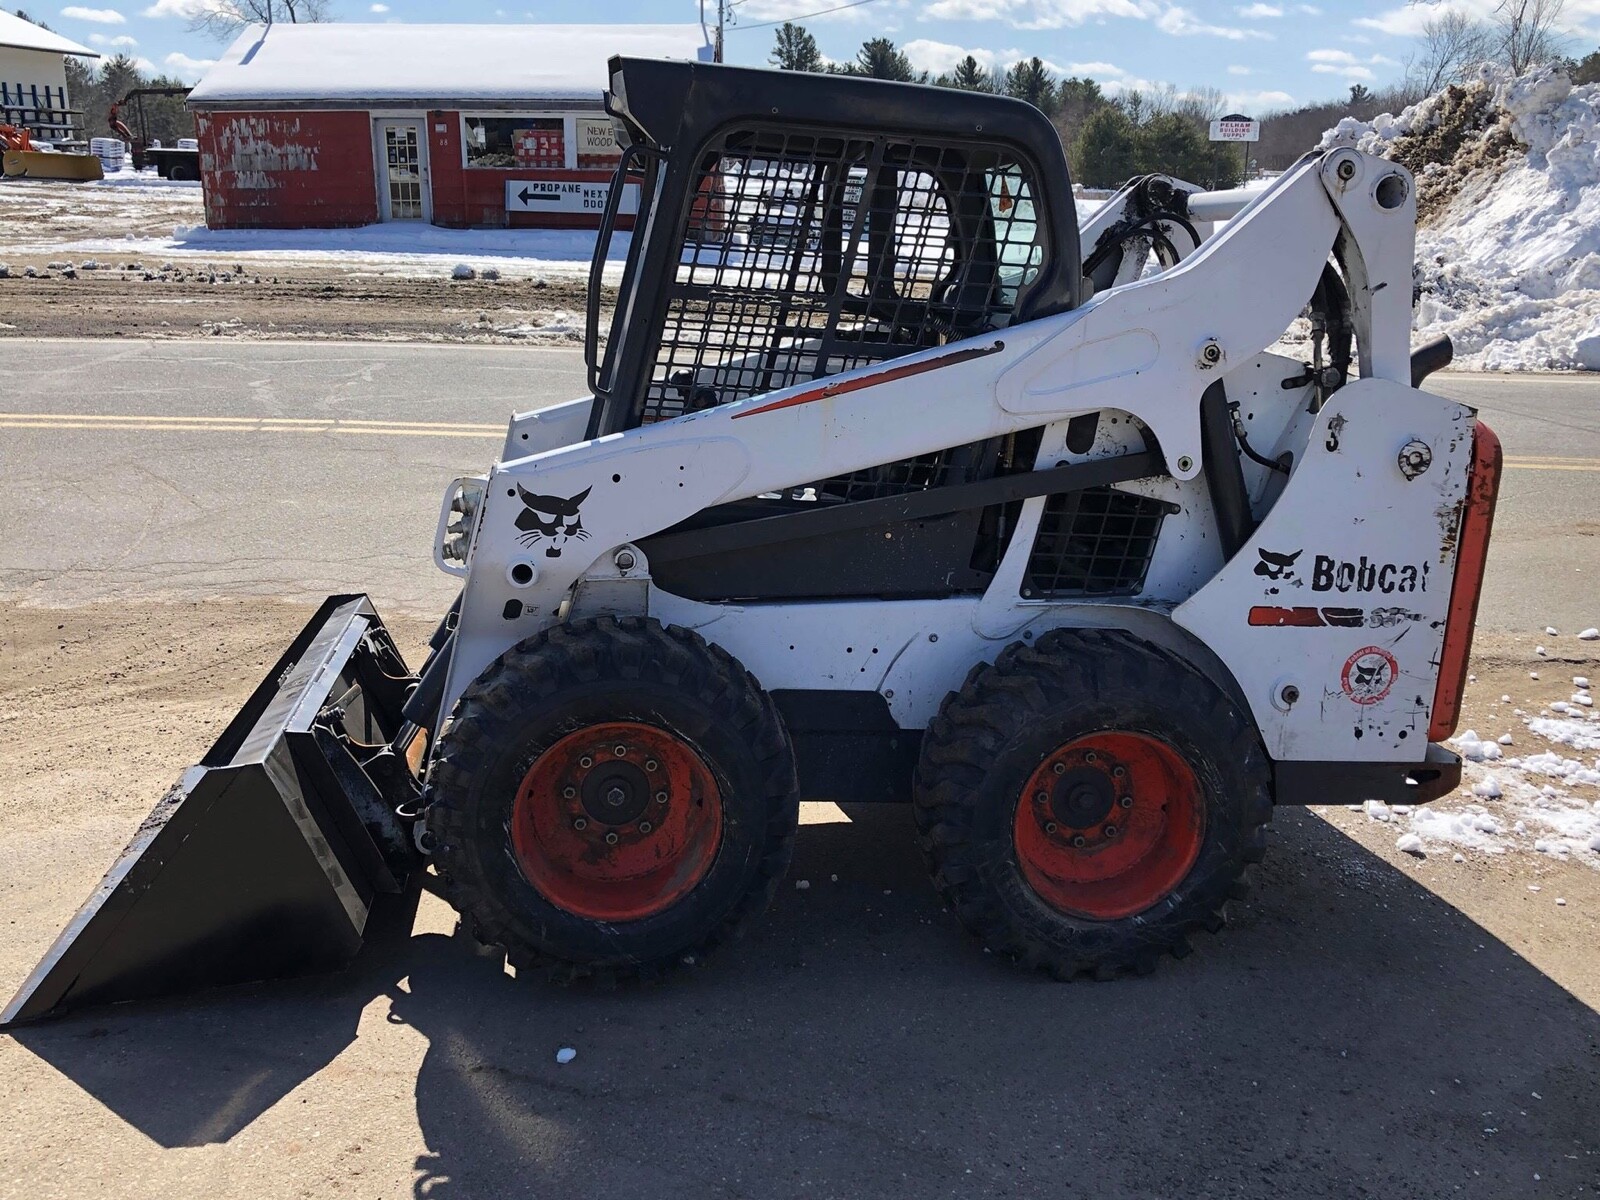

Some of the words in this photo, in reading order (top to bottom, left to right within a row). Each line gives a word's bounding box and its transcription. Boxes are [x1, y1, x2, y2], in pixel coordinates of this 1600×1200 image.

[587, 126, 606, 136] NEW
[586, 136, 613, 147] WOOD
[533, 183, 581, 193] PROPANE
[583, 199, 606, 209] DOO
